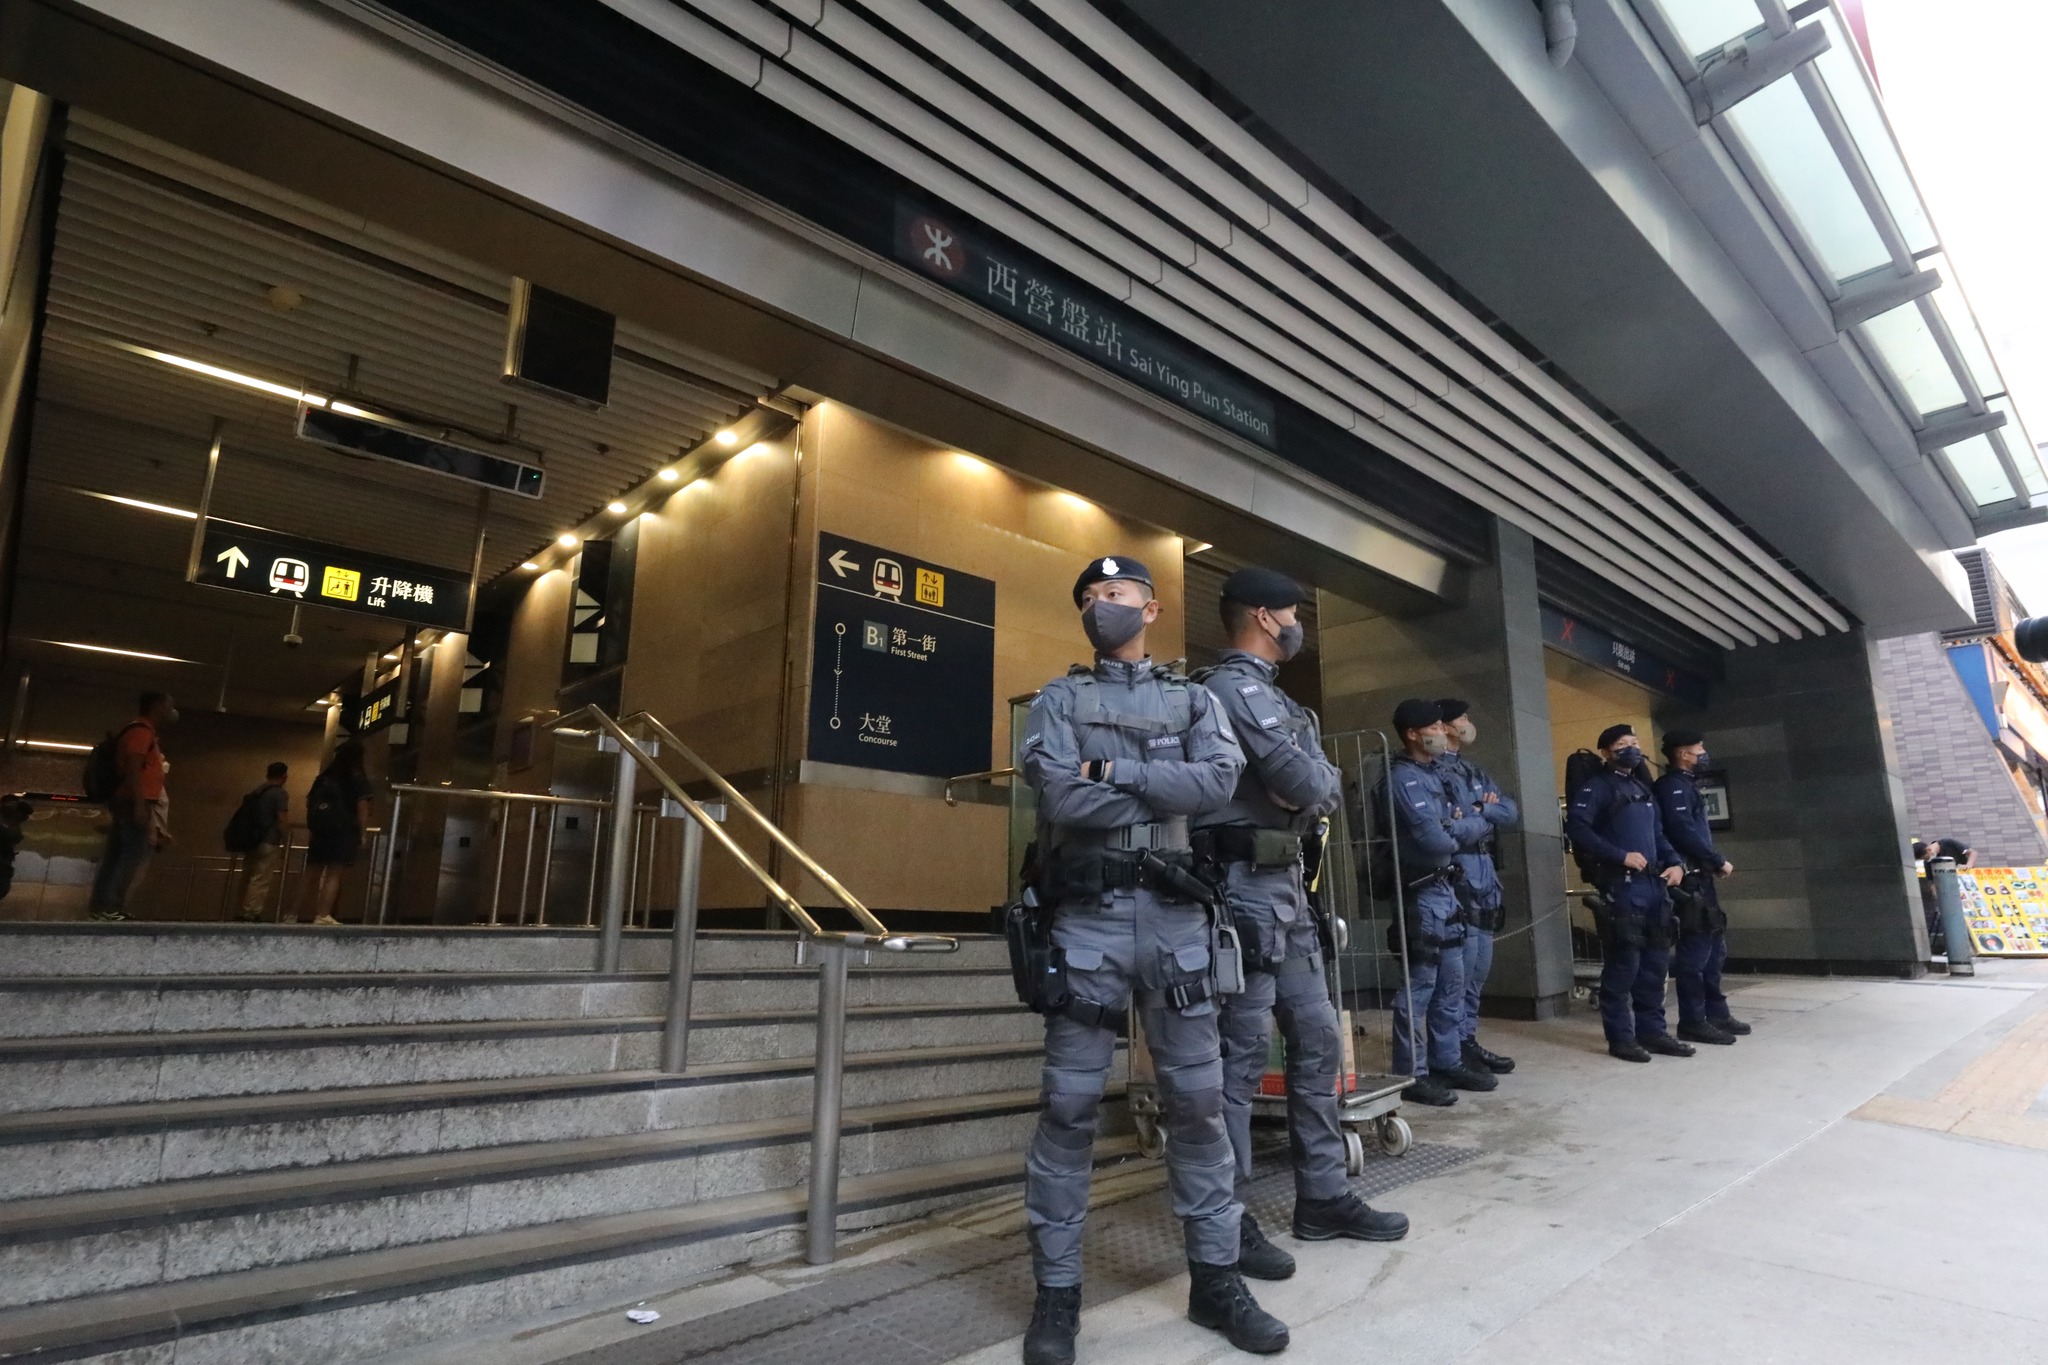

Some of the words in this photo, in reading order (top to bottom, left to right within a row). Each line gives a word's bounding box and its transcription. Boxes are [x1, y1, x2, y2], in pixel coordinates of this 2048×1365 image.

[986, 256, 1122, 361] 西營盤站
[1129, 348, 1152, 376] Sai
[1156, 361, 1189, 399] Ying
[1193, 381, 1220, 410] Pun
[1222, 398, 1269, 436] Station
[367, 595, 386, 608] Lift
[369, 576, 434, 605] 升降機
[866, 625, 884, 647] B1
[892, 627, 937, 653] 第一街
[890, 646, 907, 657] First
[907, 650, 928, 662] Street
[859, 712, 892, 735] 大堂
[858, 733, 898, 747] Concourse
